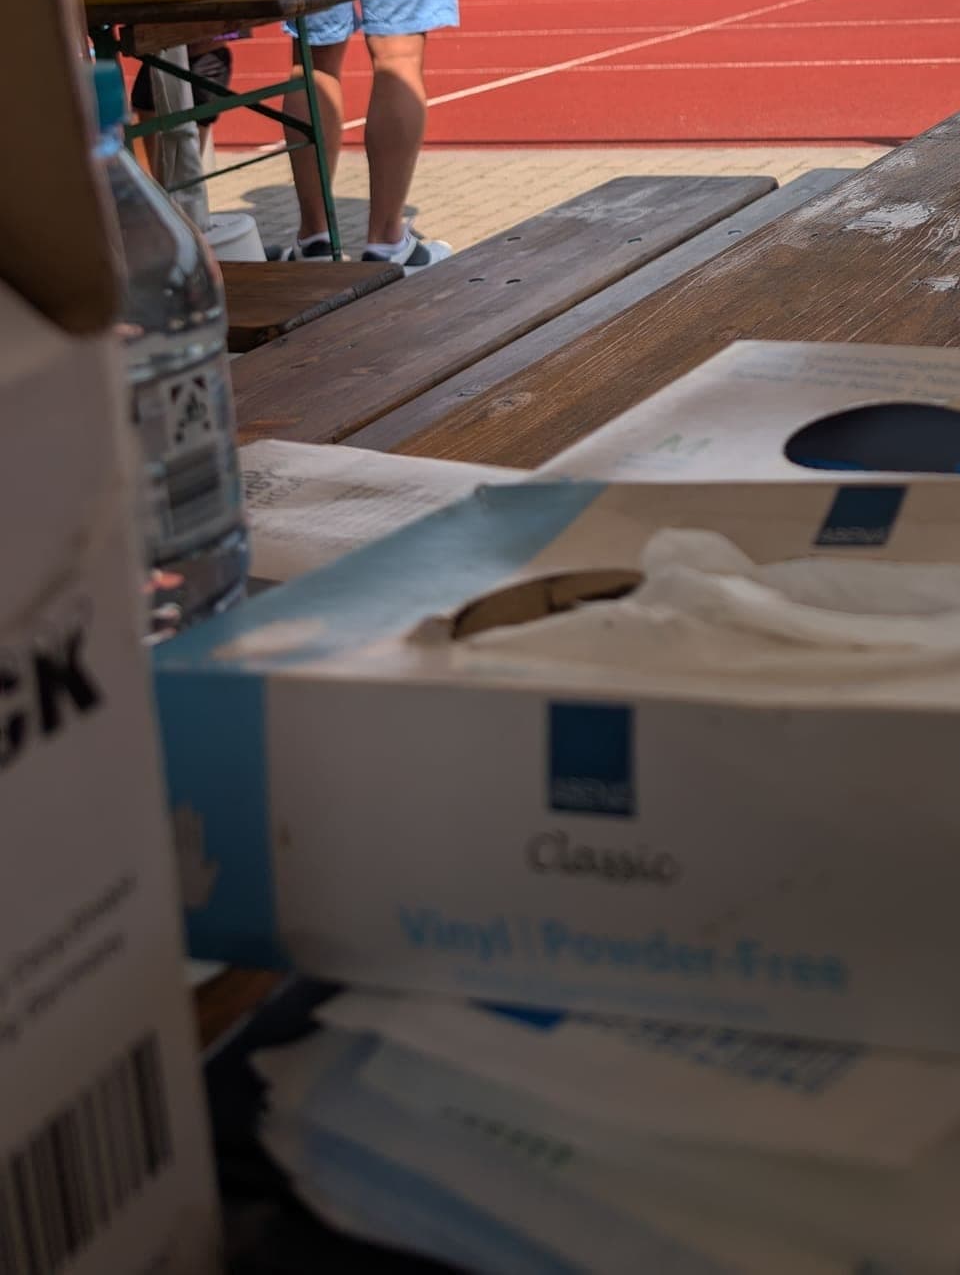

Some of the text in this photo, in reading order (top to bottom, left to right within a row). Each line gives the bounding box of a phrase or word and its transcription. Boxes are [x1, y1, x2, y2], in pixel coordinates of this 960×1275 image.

[525, 829, 682, 887] Classic
[397, 905, 512, 963] Vinyl
[540, 918, 848, 993] Powder-Free
